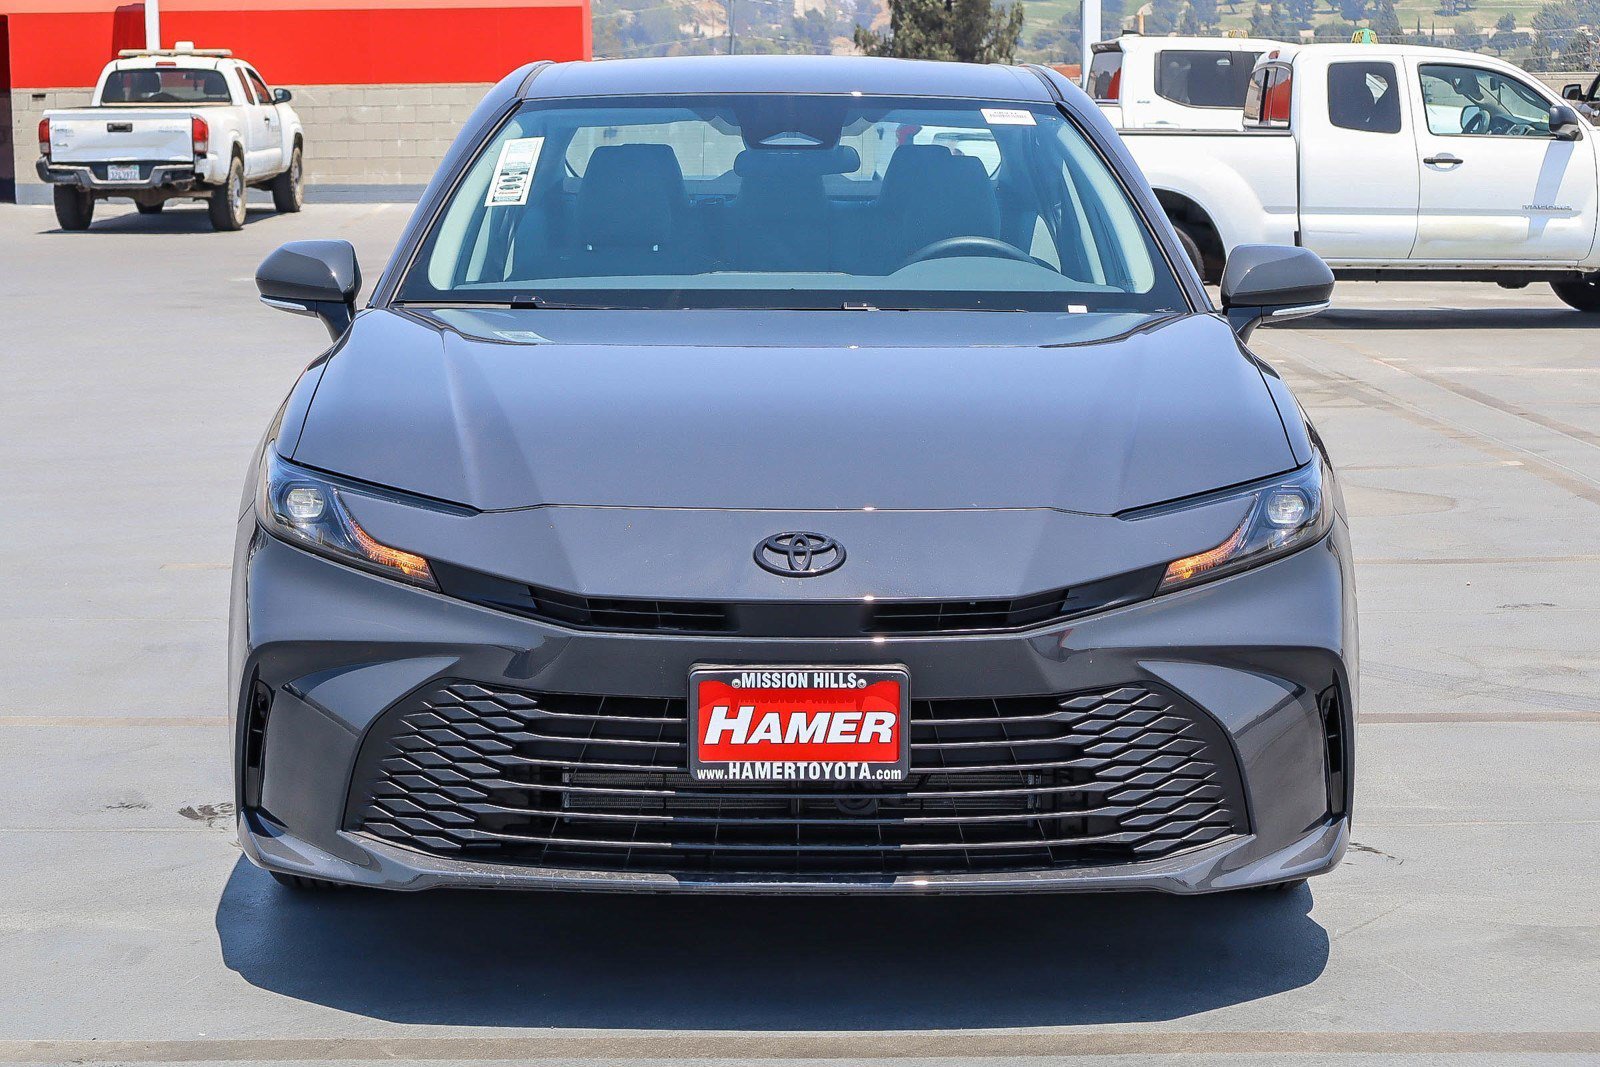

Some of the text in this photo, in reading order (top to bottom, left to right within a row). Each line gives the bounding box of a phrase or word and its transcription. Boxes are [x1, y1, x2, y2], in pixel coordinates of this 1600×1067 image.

[741, 672, 857, 689] MISSION HILLS
[703, 706, 897, 745] HAMER
[697, 762, 902, 780] www.HAMERTOYOTA.com
